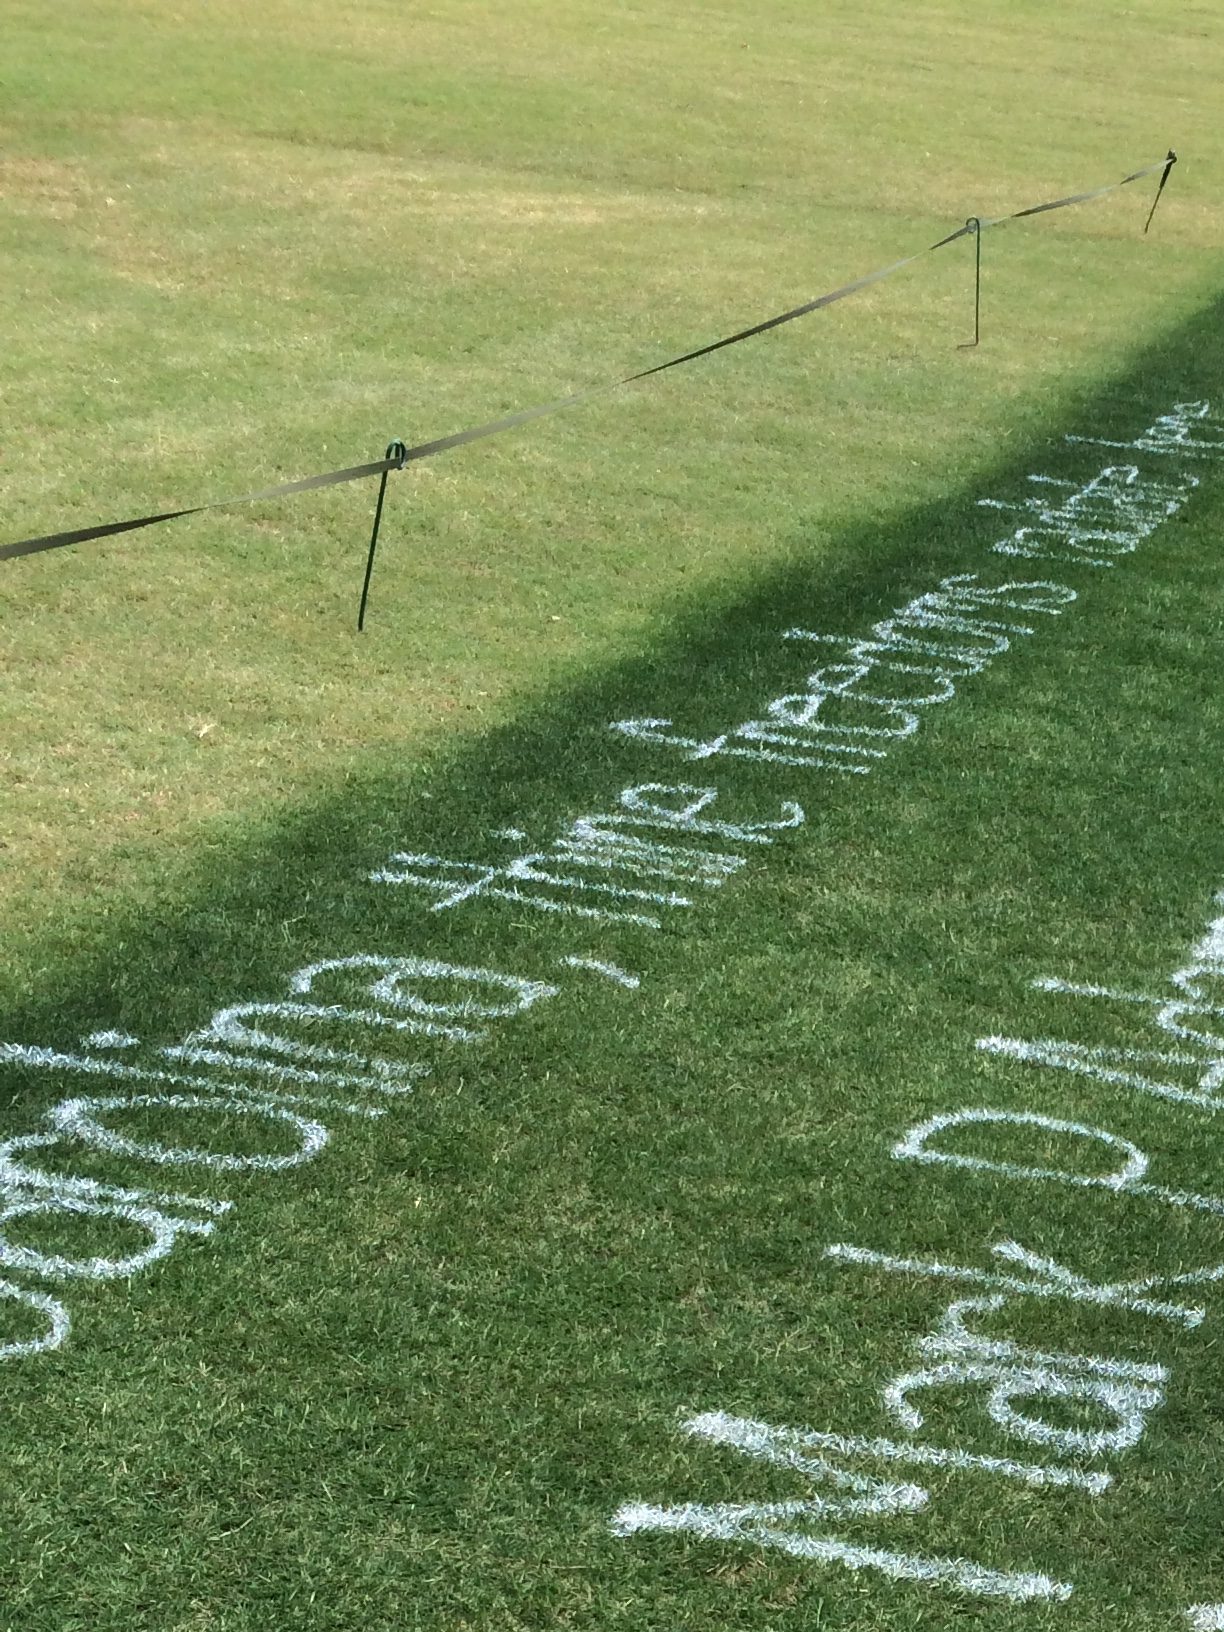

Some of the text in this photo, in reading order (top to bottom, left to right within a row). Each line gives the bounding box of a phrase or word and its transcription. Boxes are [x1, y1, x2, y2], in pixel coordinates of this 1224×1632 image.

[0, 953, 641, 1360] arolina,
[368, 781, 805, 930] thine
[610, 573, 1078, 775] freedoms
[976, 464, 1201, 567] radiate
